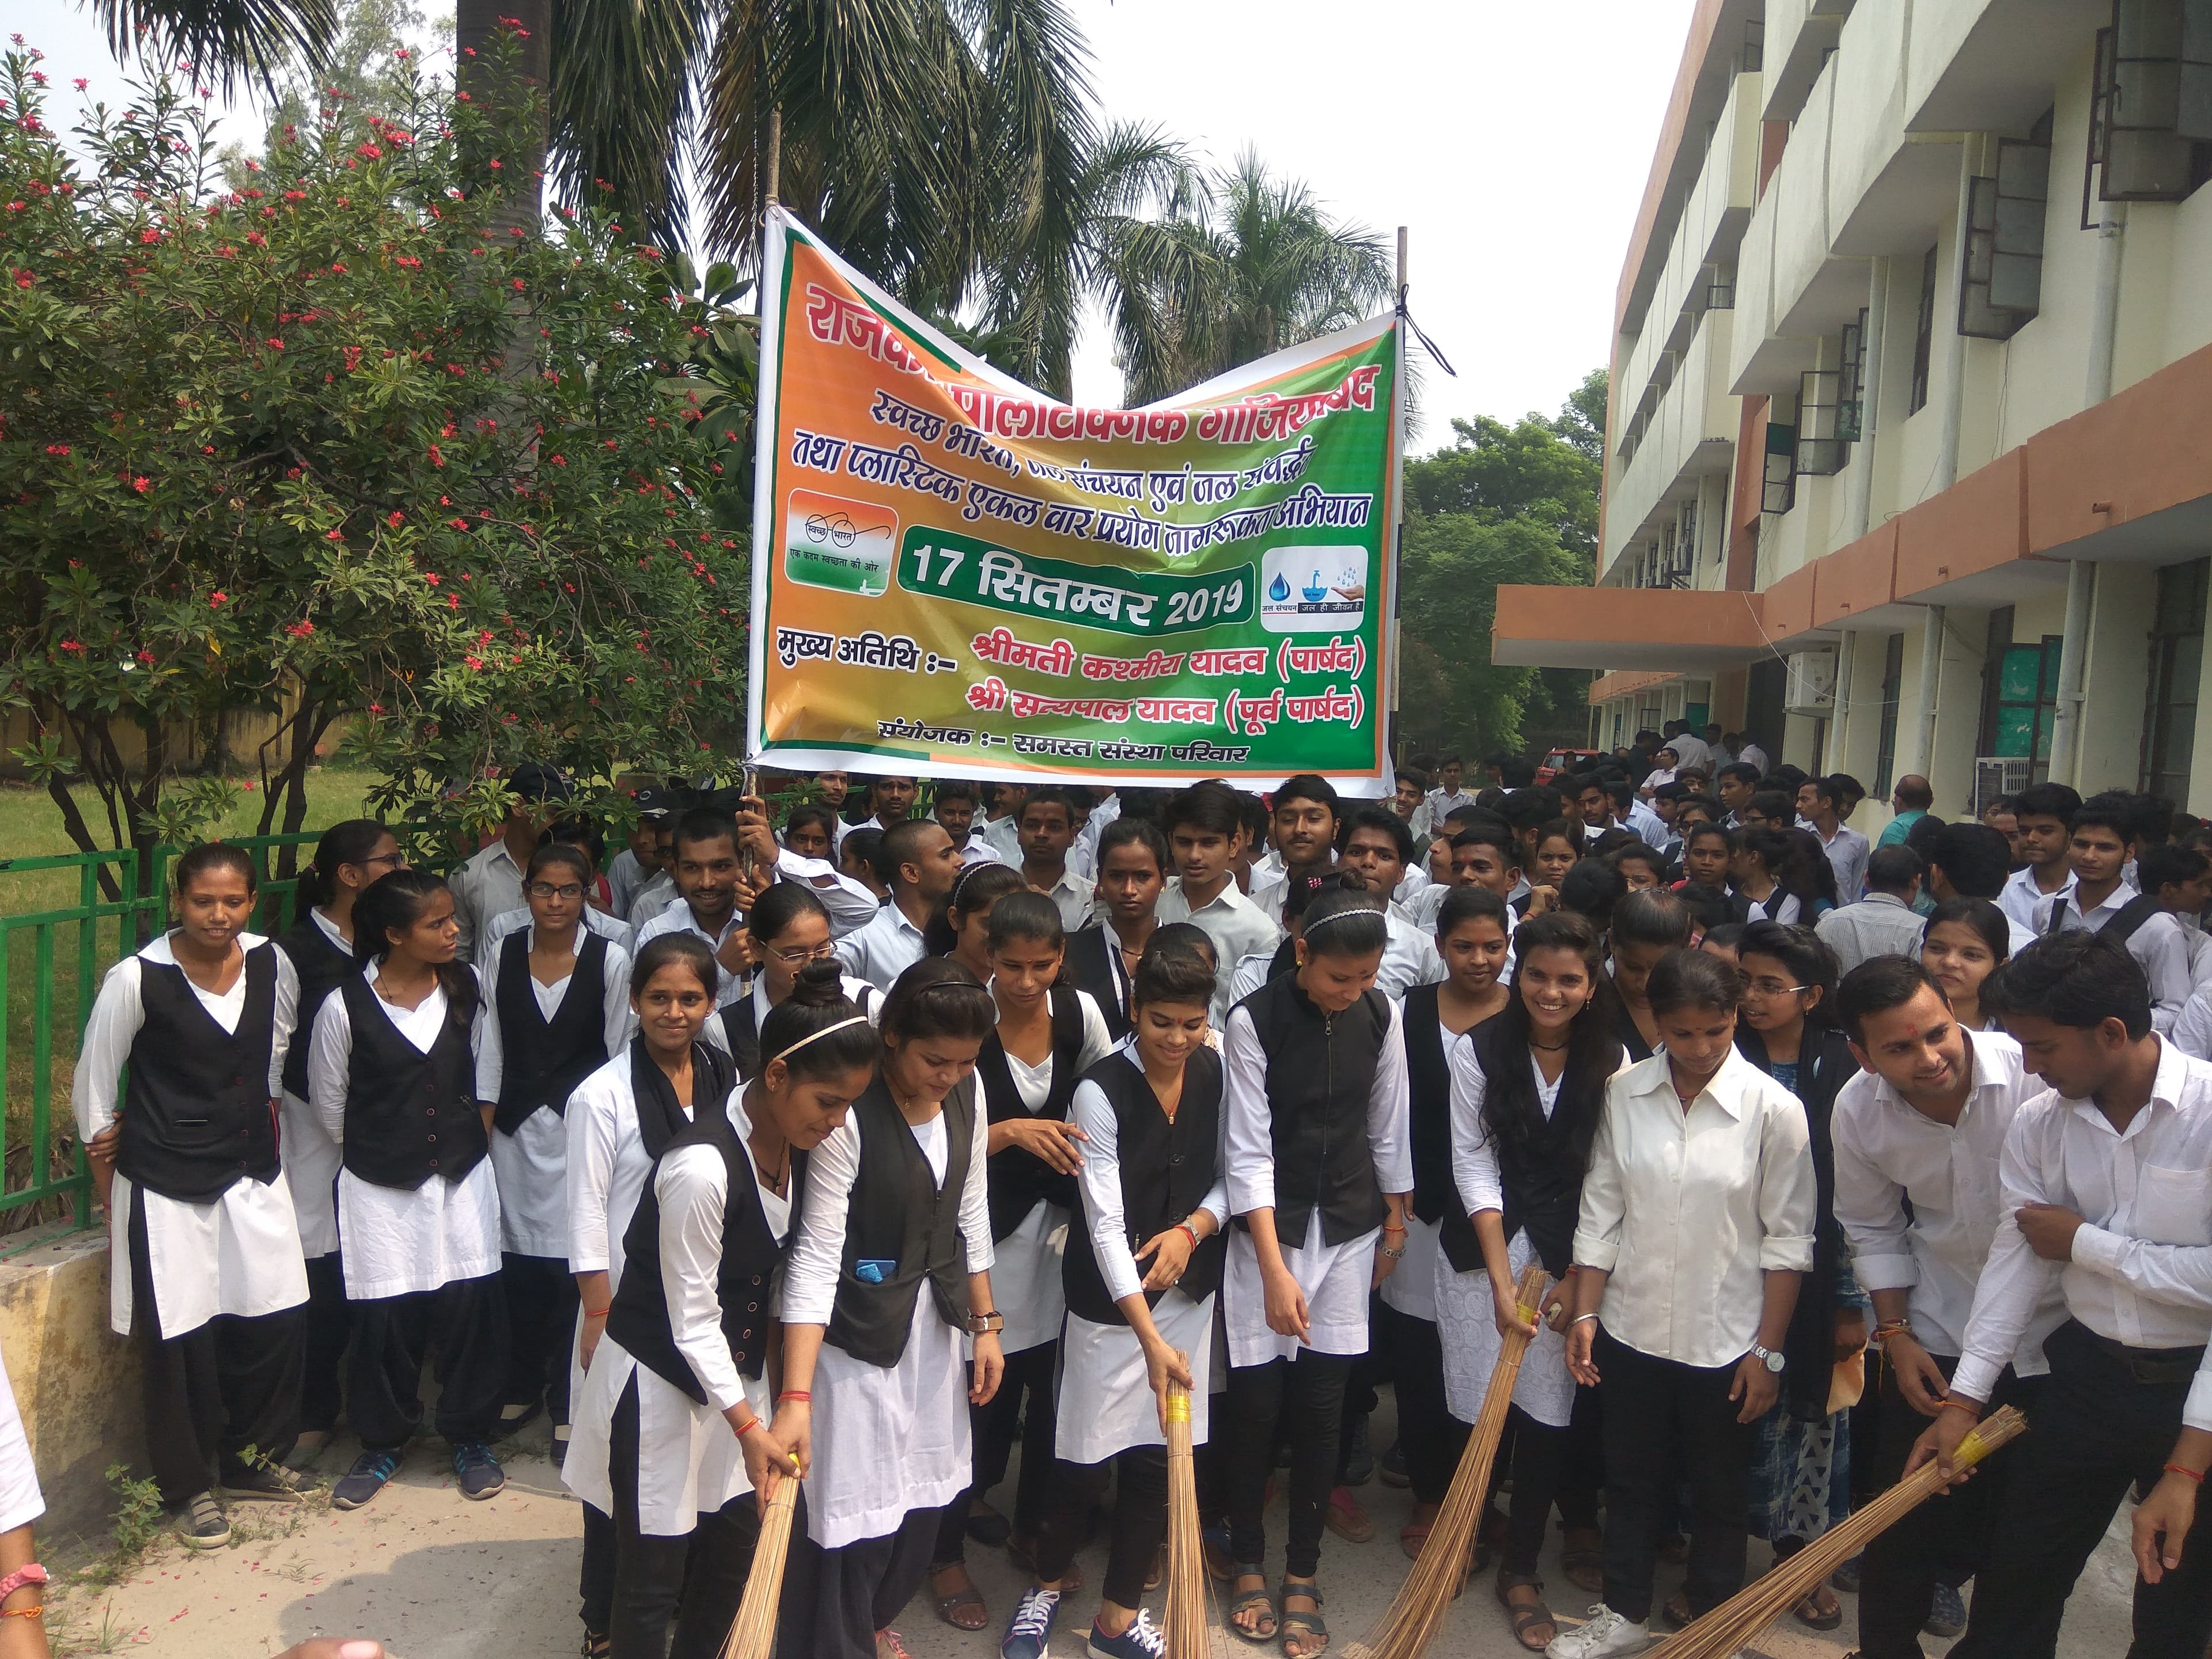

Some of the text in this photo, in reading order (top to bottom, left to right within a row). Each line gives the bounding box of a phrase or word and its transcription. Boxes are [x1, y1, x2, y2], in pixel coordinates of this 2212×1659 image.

[808, 284, 935, 382] राजक
[872, 390, 945, 441] स्वच्छ
[1066, 462, 1143, 499] संचयन
[1150, 464, 1190, 512] एवं
[1192, 473, 1238, 502] जल
[793, 431, 846, 471] तथा
[849, 444, 965, 502] प्लास्टिक
[963, 483, 1043, 520] एकल
[1094, 507, 1160, 550] प्रयोग
[1272, 485, 1372, 526] अभियान
[808, 525, 853, 541] स्वच्छ भारत
[790, 548, 879, 573] एक कदम स्वच्छता की ओर
[912, 544, 1244, 627] 17 सितम्बर 2019
[1276, 604, 1297, 612] संचयन
[1320, 603, 1328, 612] ही
[1332, 603, 1353, 612] जीवन
[1355, 602, 1361, 611] है
[777, 627, 834, 666] मुख्य
[838, 631, 920, 671] अतिथि
[974, 628, 1075, 675] श्रीमती
[1083, 651, 1185, 680] कश्मीरा
[1190, 648, 1268, 674] यादव
[1277, 636, 1365, 681] (पार्षद)
[967, 677, 1365, 734] श्री सत्यपाल यादव (पूर्व पार्षद)
[878, 718, 975, 744] संयोजक
[1014, 735, 1093, 756] समस्त
[1099, 738, 1166, 760] संस्था
[1171, 741, 1249, 761] परिवार
